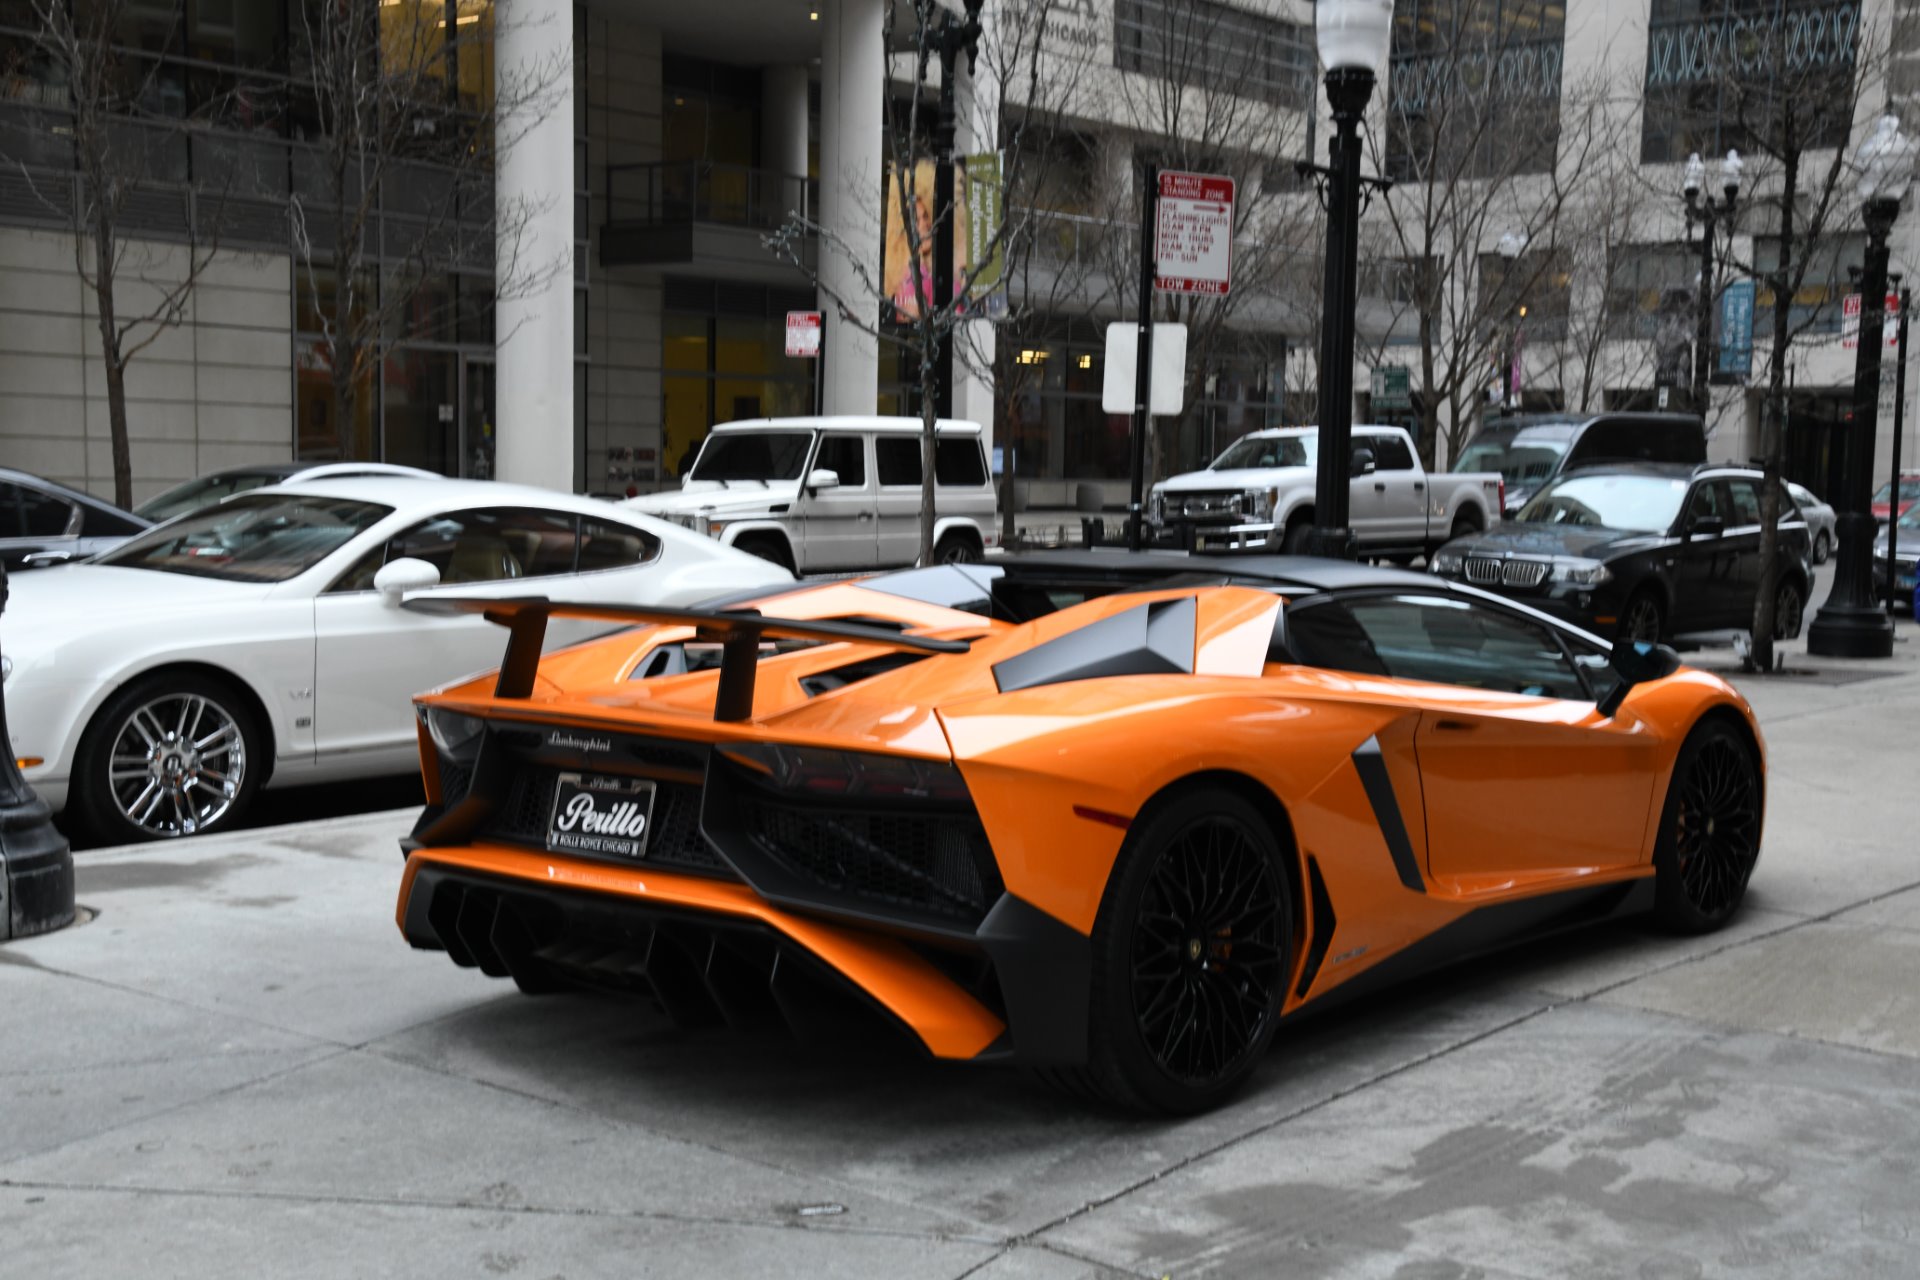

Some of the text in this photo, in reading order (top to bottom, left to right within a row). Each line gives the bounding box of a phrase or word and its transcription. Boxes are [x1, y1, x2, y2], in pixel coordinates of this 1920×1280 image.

[1175, 177, 1202, 187] MINUTE
[1164, 186, 1225, 200] STANDING ZONE
[1162, 202, 1177, 211] USE
[1162, 213, 1228, 227] FLASHING LIGHTS
[1162, 223, 1170, 231] 10
[1199, 226, 1211, 234] PM
[1189, 234, 1214, 244] THURS
[1161, 242, 1168, 250] 10
[1170, 243, 1182, 251] AM
[1160, 252, 1173, 261] FRI
[1181, 254, 1198, 262] SUN
[1161, 278, 1222, 293] TOW ZONE
[548, 730, 611, 752] Lamborghini
[557, 793, 645, 837] Perillo
[602, 839, 631, 855] CHICAGO
